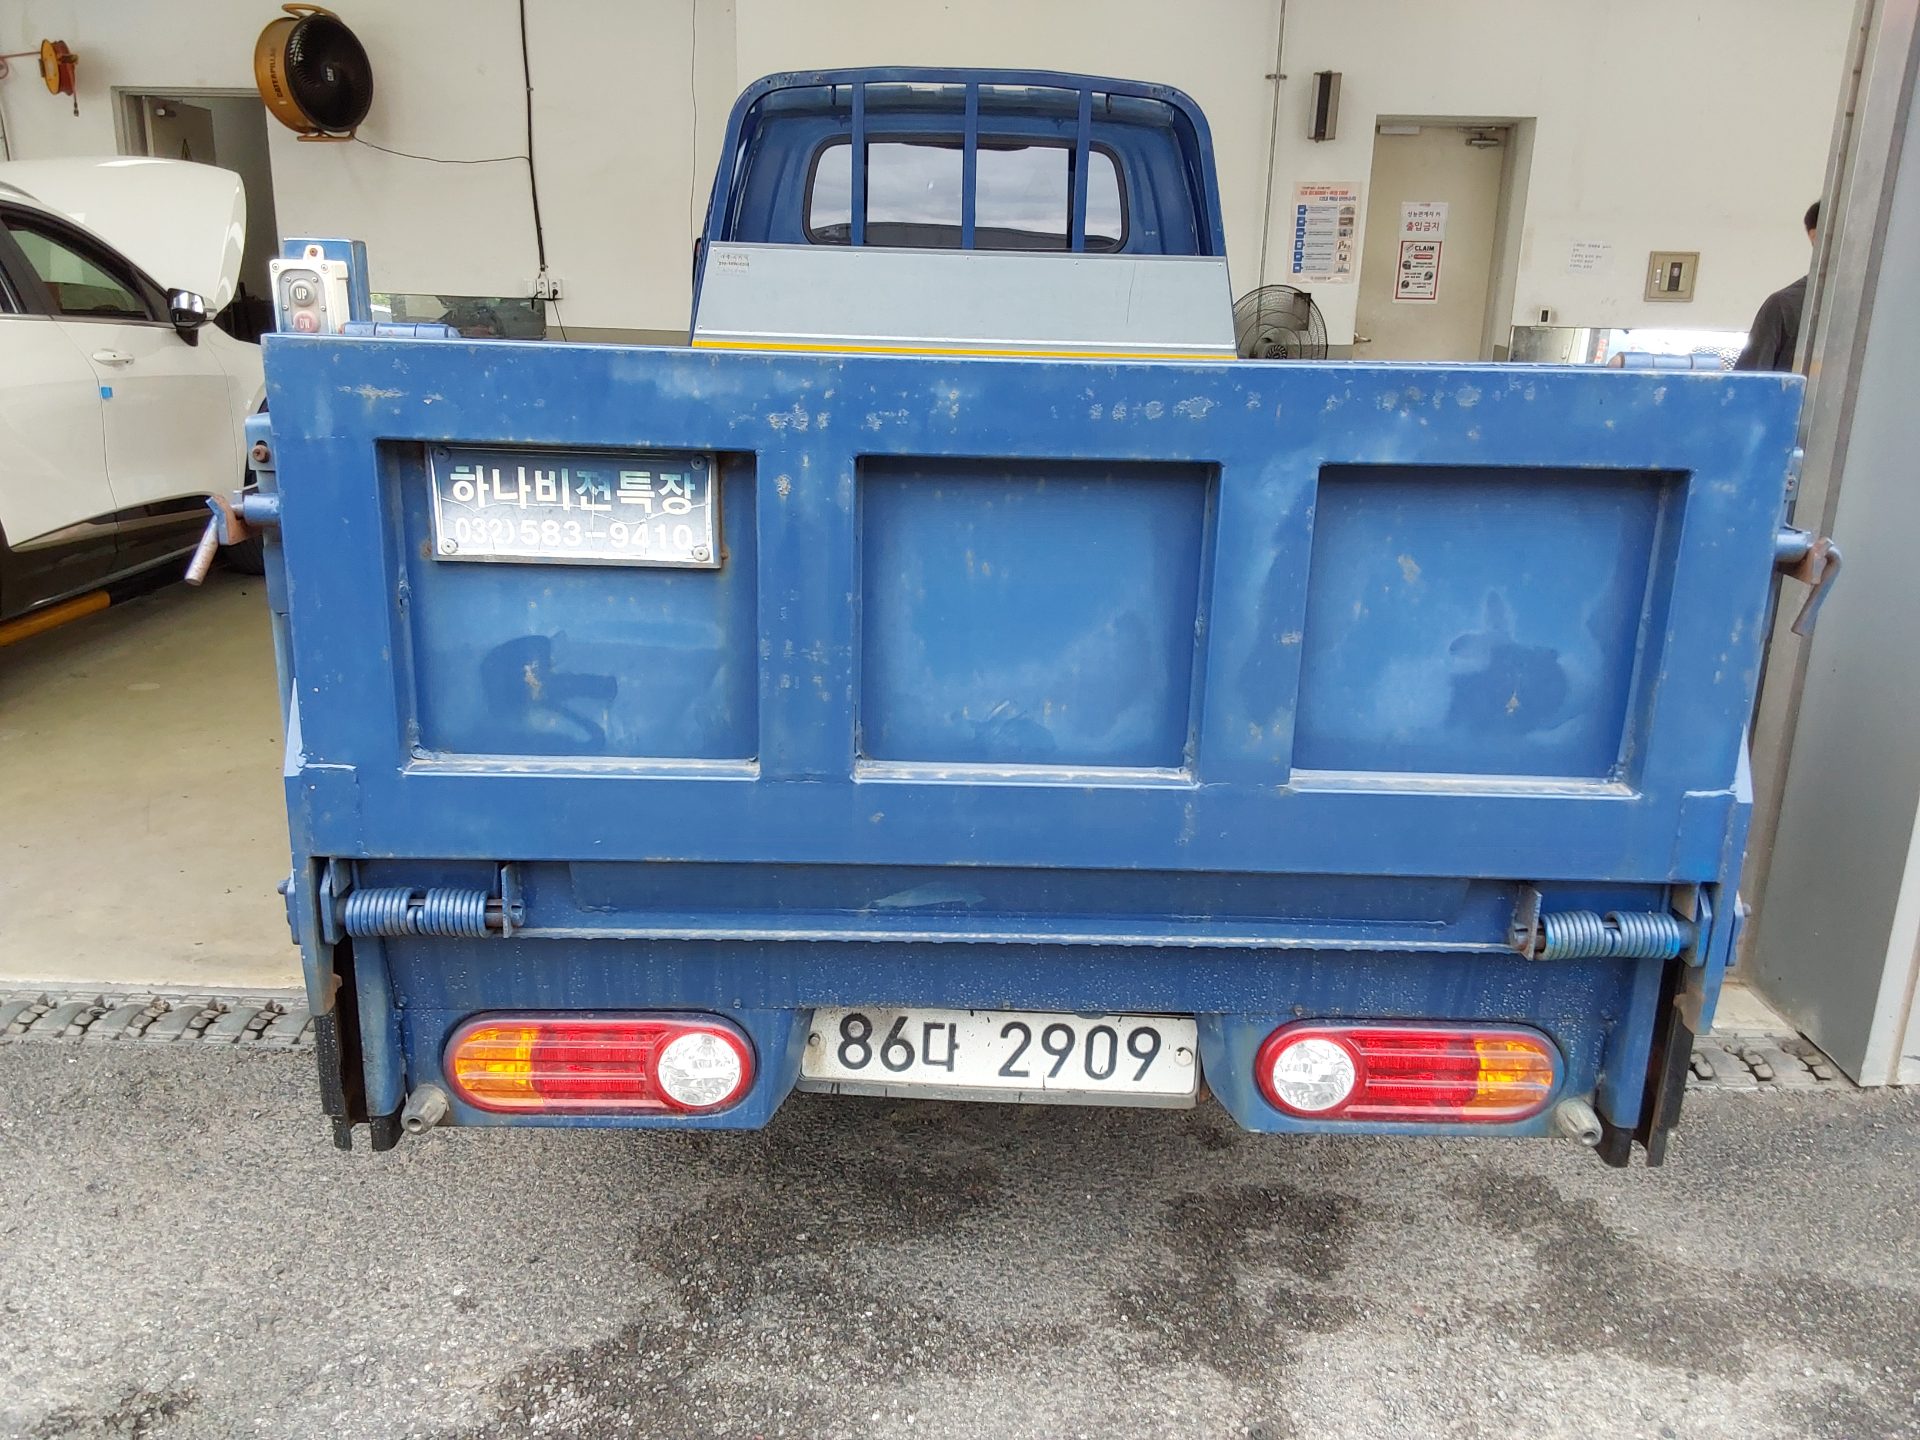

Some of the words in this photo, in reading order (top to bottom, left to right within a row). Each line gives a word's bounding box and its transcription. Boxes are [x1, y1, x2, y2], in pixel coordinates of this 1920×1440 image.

[269, 47, 284, 98] CATERPILL
[1406, 221, 1440, 232] 출입금지
[295, 287, 308, 300] UP
[837, 1012, 960, 1073] 86다
[997, 1021, 1163, 1082] 2909
